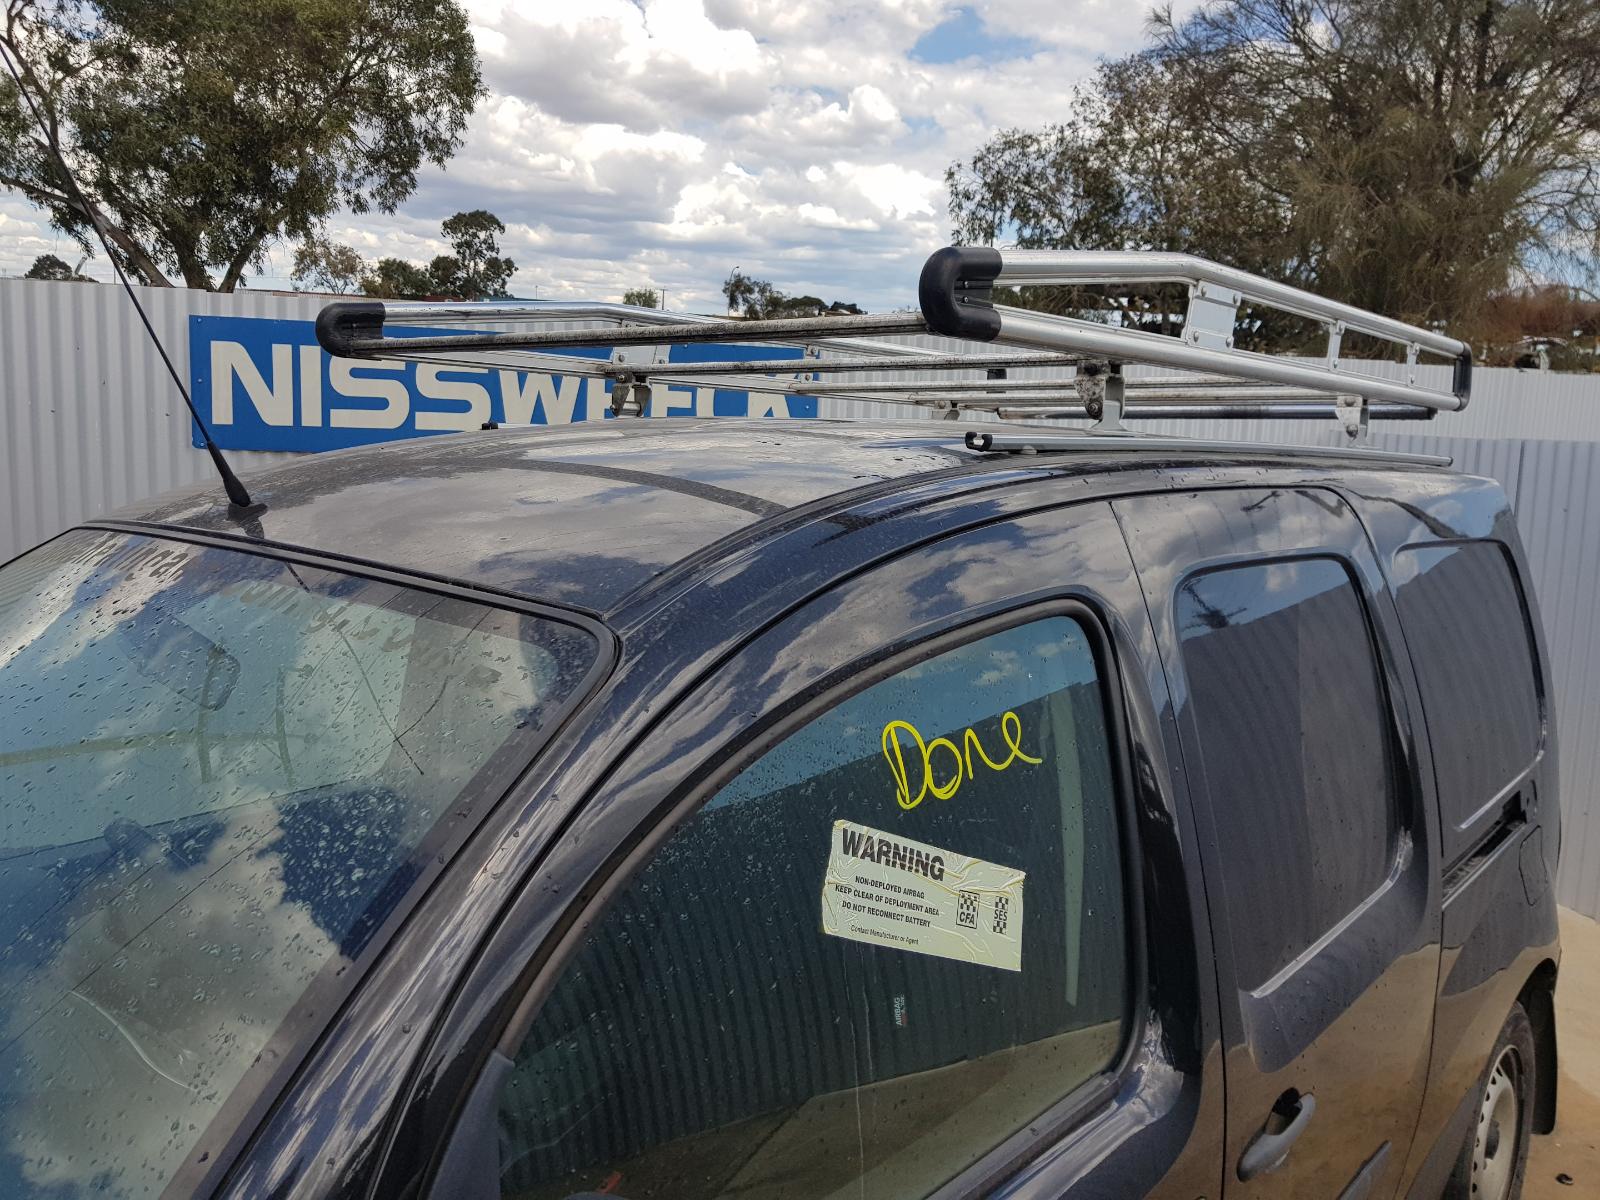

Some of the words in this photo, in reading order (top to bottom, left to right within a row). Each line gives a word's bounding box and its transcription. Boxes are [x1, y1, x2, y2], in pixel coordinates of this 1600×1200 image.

[882, 711, 1042, 810] Done
[842, 828, 945, 882] WARNING
[835, 884, 853, 896] KEEP
[853, 888, 874, 902] CLEAR
[874, 895, 884, 904] OF
[884, 897, 924, 914] DEPLOYMENT
[924, 906, 940, 917] AREA
[855, 876, 902, 894] NON-DEPLOYED
[903, 887, 925, 900] AIRBAG
[842, 900, 851, 910] DO
[852, 903, 867, 915] NOT
[867, 906, 905, 923] RECONNECT
[905, 915, 932, 928] BATTERY
[959, 913, 976, 926] CFA
[993, 909, 1008, 922] SES
[850, 924, 870, 934] Contact
[905, 936, 920, 946] Agent
